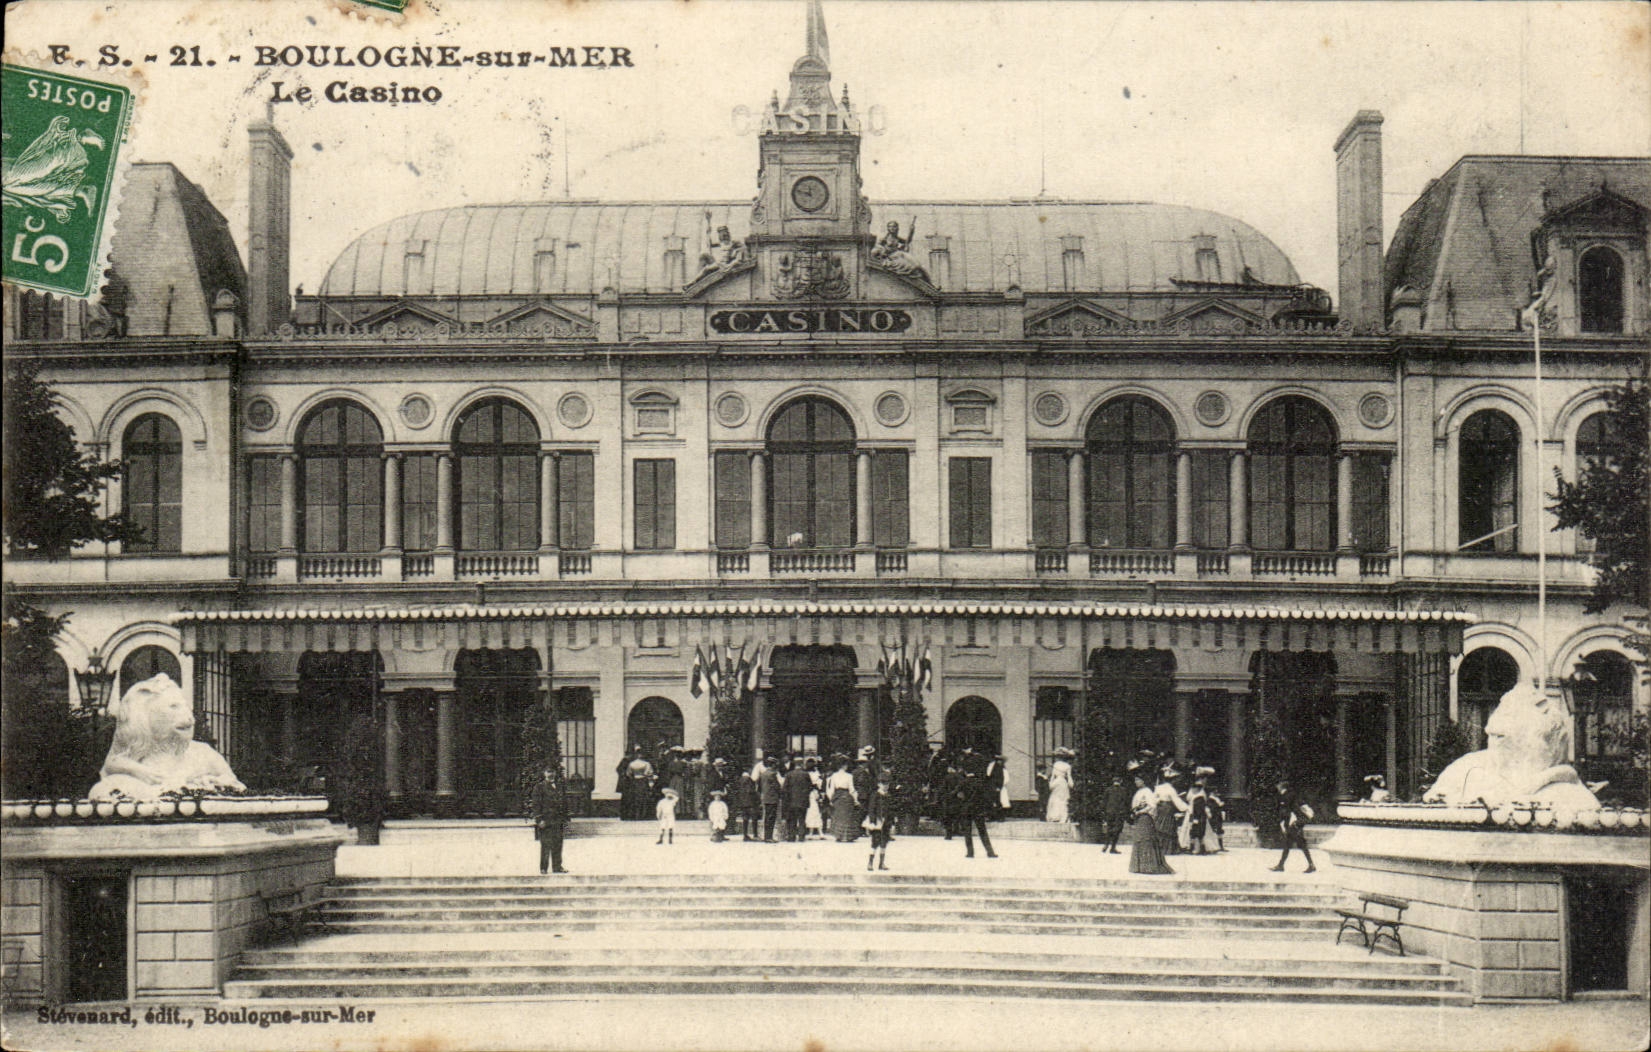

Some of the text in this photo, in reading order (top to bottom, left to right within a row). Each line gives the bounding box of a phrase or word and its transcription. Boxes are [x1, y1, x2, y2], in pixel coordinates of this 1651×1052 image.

[27, 78, 112, 113] POSTES
[731, 103, 887, 136] CASINO
[727, 311, 894, 332] CASINO
